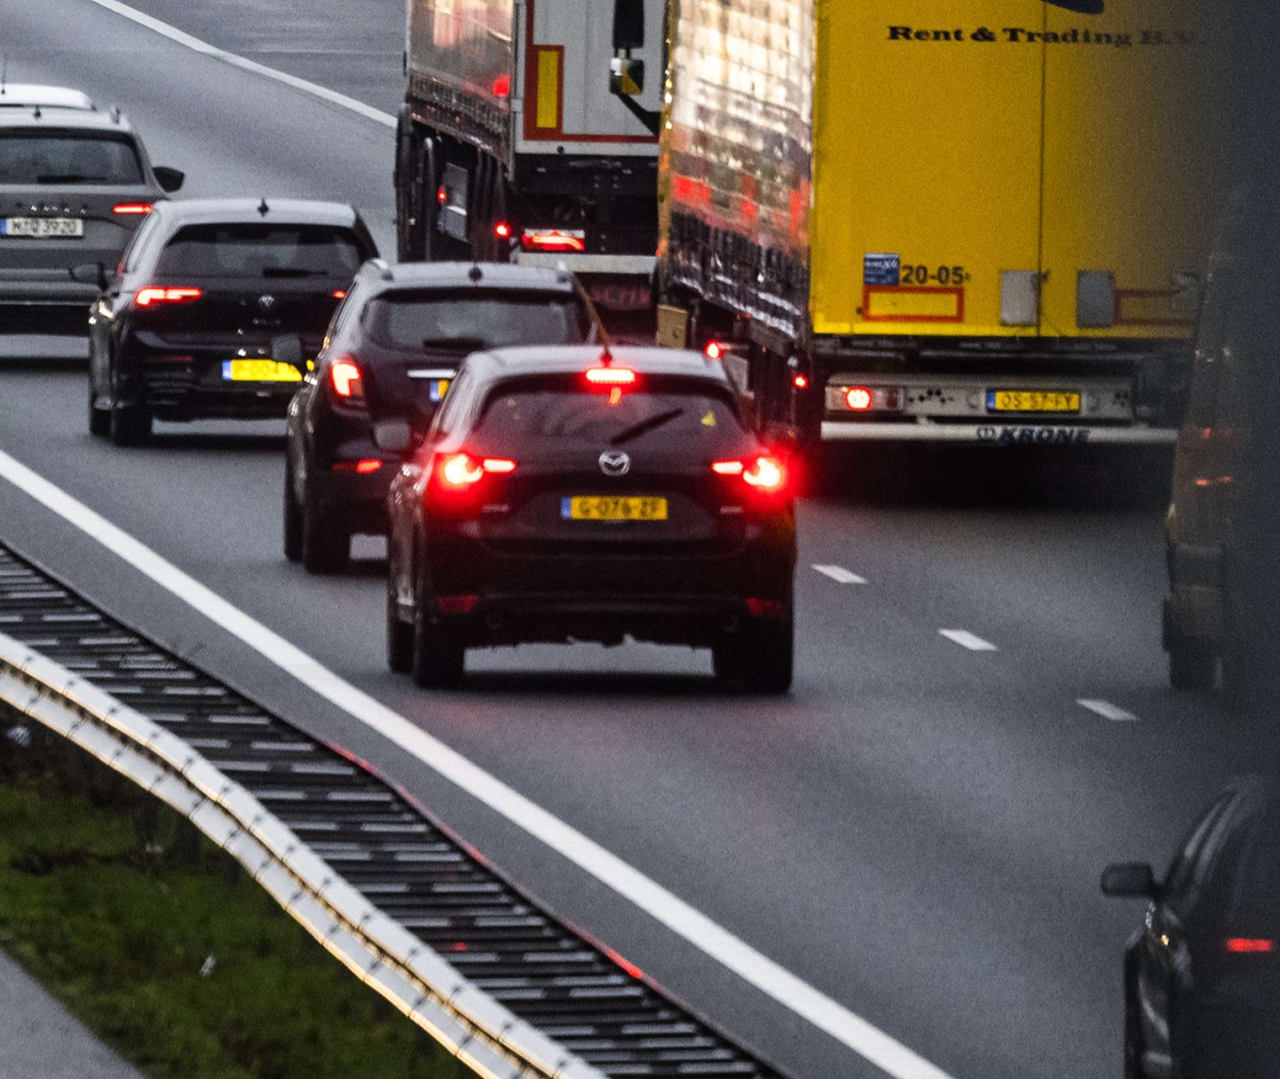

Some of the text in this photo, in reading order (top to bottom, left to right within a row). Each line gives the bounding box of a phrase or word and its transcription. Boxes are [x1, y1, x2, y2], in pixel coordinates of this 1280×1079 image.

[888, 26, 963, 41] Rent
[971, 28, 996, 42] &
[1003, 27, 1132, 48] Trading
[1000, 428, 1090, 441] KRONE
